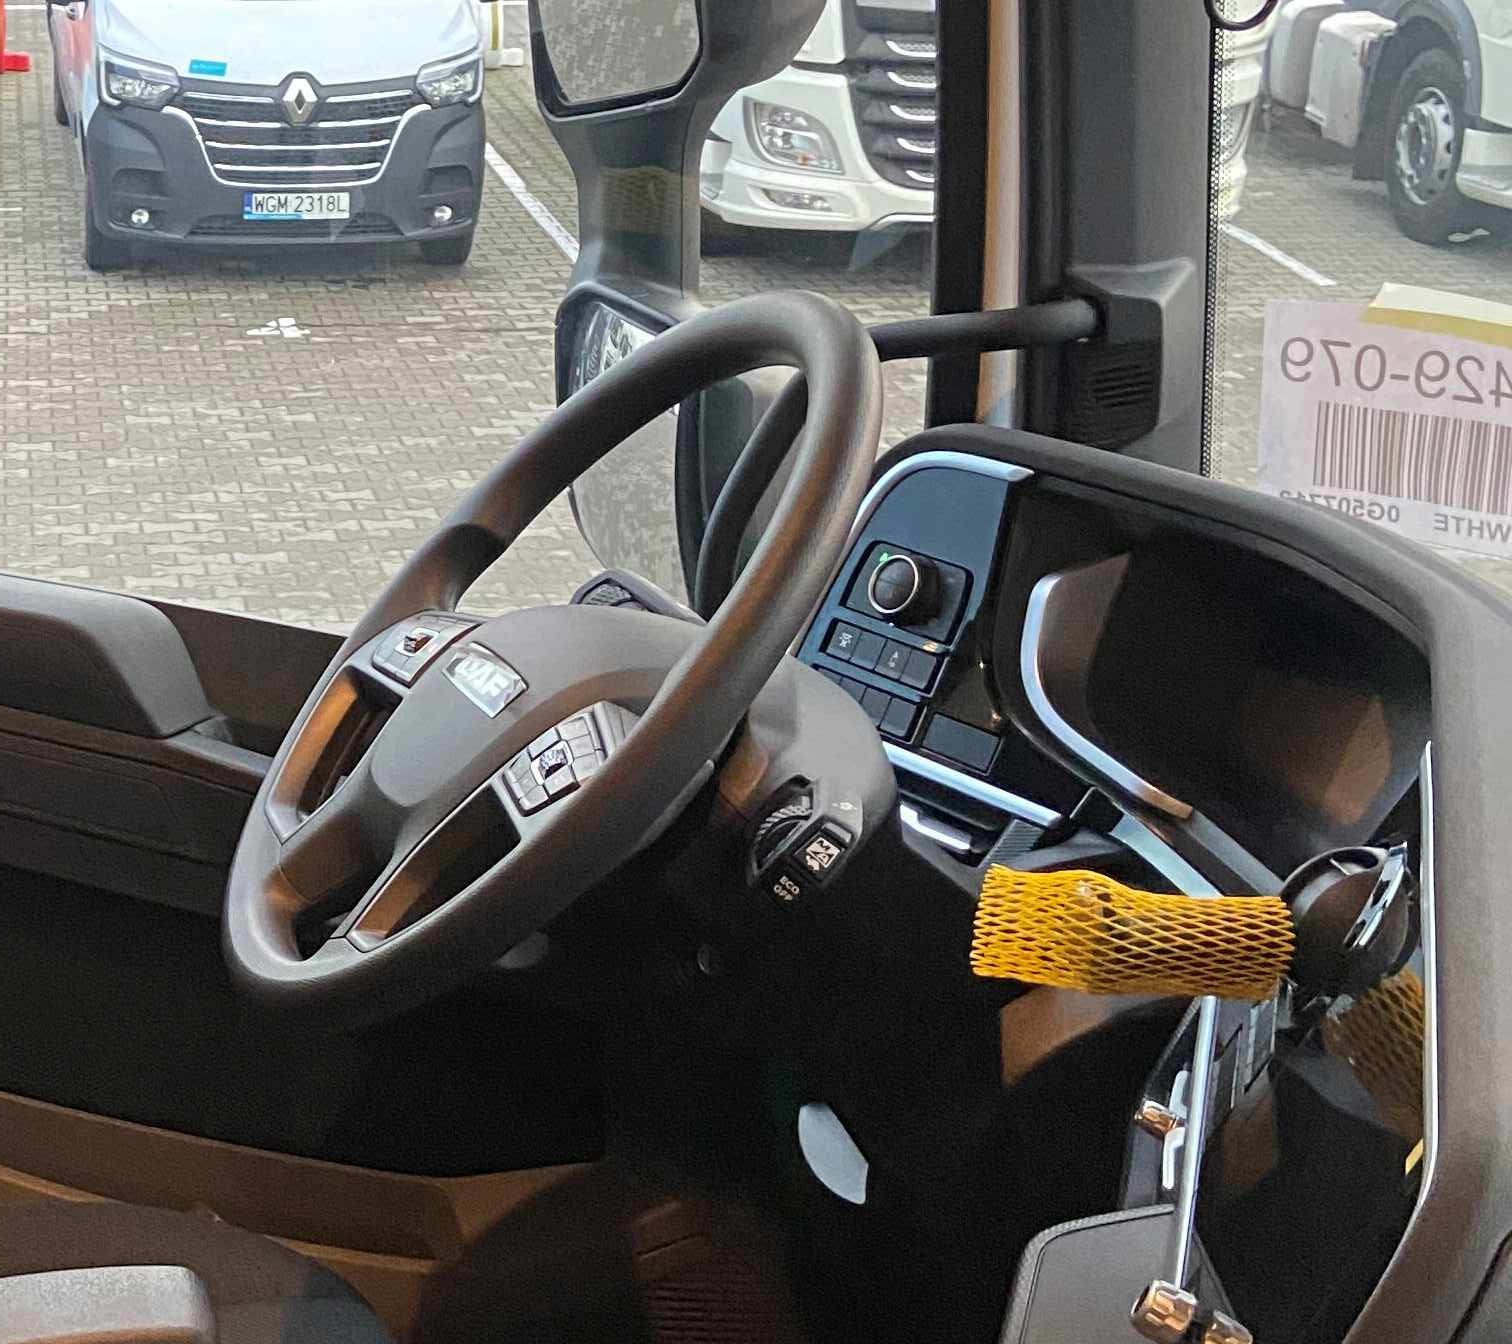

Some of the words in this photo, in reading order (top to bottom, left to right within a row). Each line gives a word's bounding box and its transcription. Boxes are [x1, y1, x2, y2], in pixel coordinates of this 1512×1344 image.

[254, 196, 288, 213] WGM
[294, 195, 346, 212] 2318L
[779, 876, 800, 895] ECO
